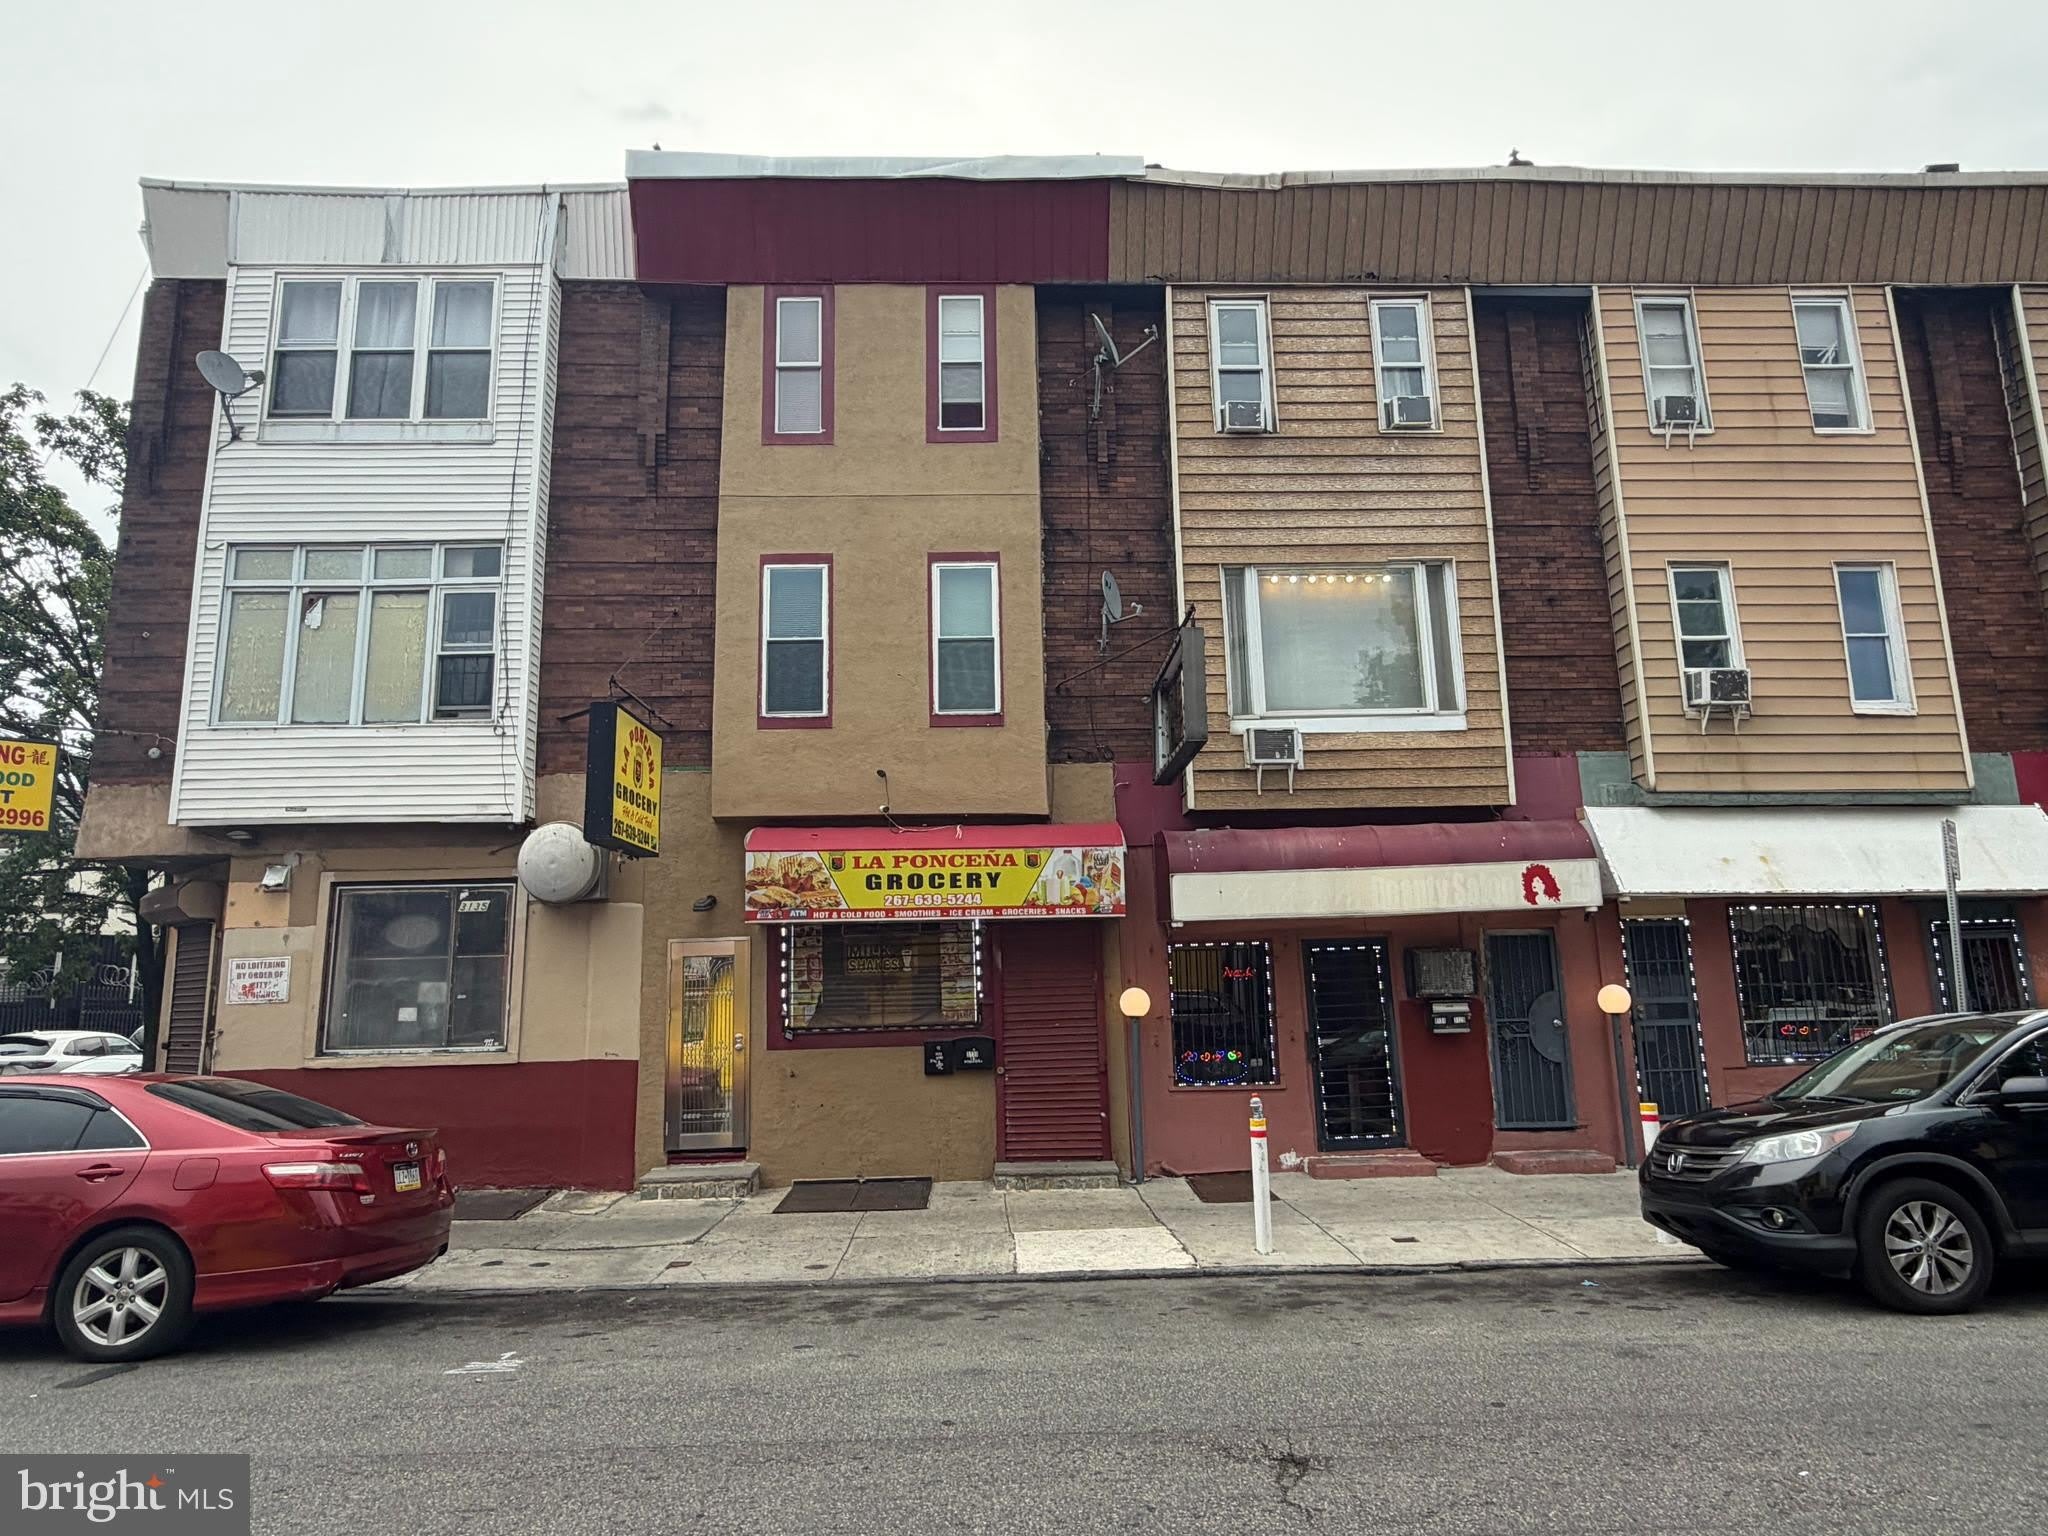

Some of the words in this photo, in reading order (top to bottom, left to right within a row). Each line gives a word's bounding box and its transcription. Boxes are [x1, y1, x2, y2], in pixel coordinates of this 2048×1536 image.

[615, 782, 658, 817] GROCERY
[613, 817, 651, 848] 267-639-5244
[852, 855, 885, 870] LA
[892, 850, 1018, 869] PONCEÑA
[865, 871, 1002, 891] GROCERY
[884, 892, 983, 907] 267-639-5244
[460, 902, 488, 911] 3135
[789, 909, 807, 917] ATM
[813, 911, 829, 919] HOT
[840, 911, 862, 919] COLD
[863, 910, 886, 918] FOOD
[894, 909, 941, 918] SMOOTHIES
[949, 909, 963, 917] ICE
[1001, 908, 1047, 916] GROCERIES
[1055, 907, 1087, 915] SNACKS
[235, 962, 246, 970] NO
[247, 961, 286, 970] LOITERING
[237, 972, 247, 980] BY
[248, 971, 273, 979] ORDER
[274, 970, 284, 979] OF
